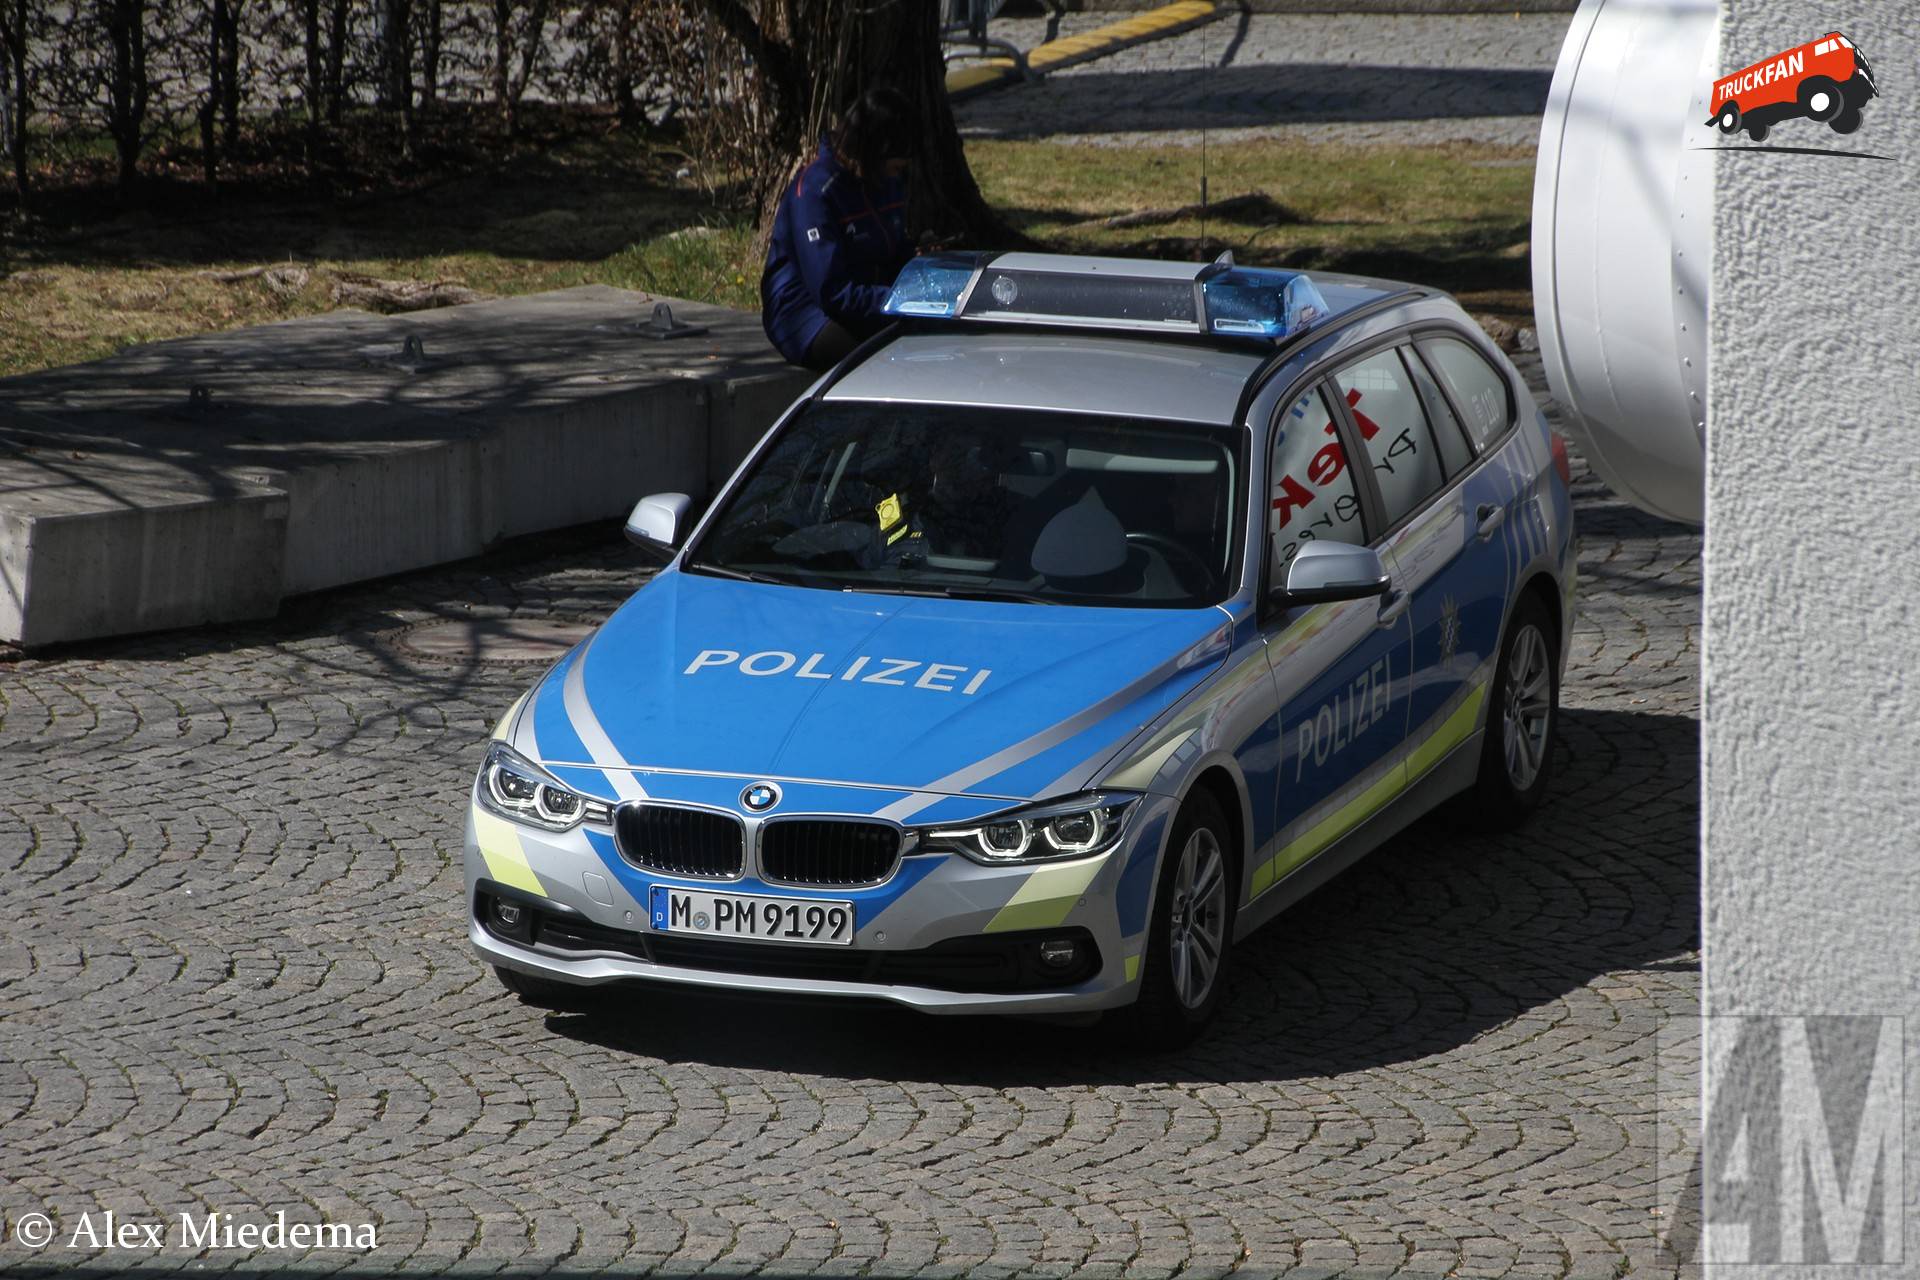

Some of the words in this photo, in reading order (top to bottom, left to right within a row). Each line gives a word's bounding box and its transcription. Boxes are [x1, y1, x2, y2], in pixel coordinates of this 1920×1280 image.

[683, 649, 993, 696] POLIZEI
[1295, 651, 1391, 784] POLIZEI
[671, 894, 691, 928] M
[713, 898, 756, 934] PM
[763, 903, 848, 940] 9199
